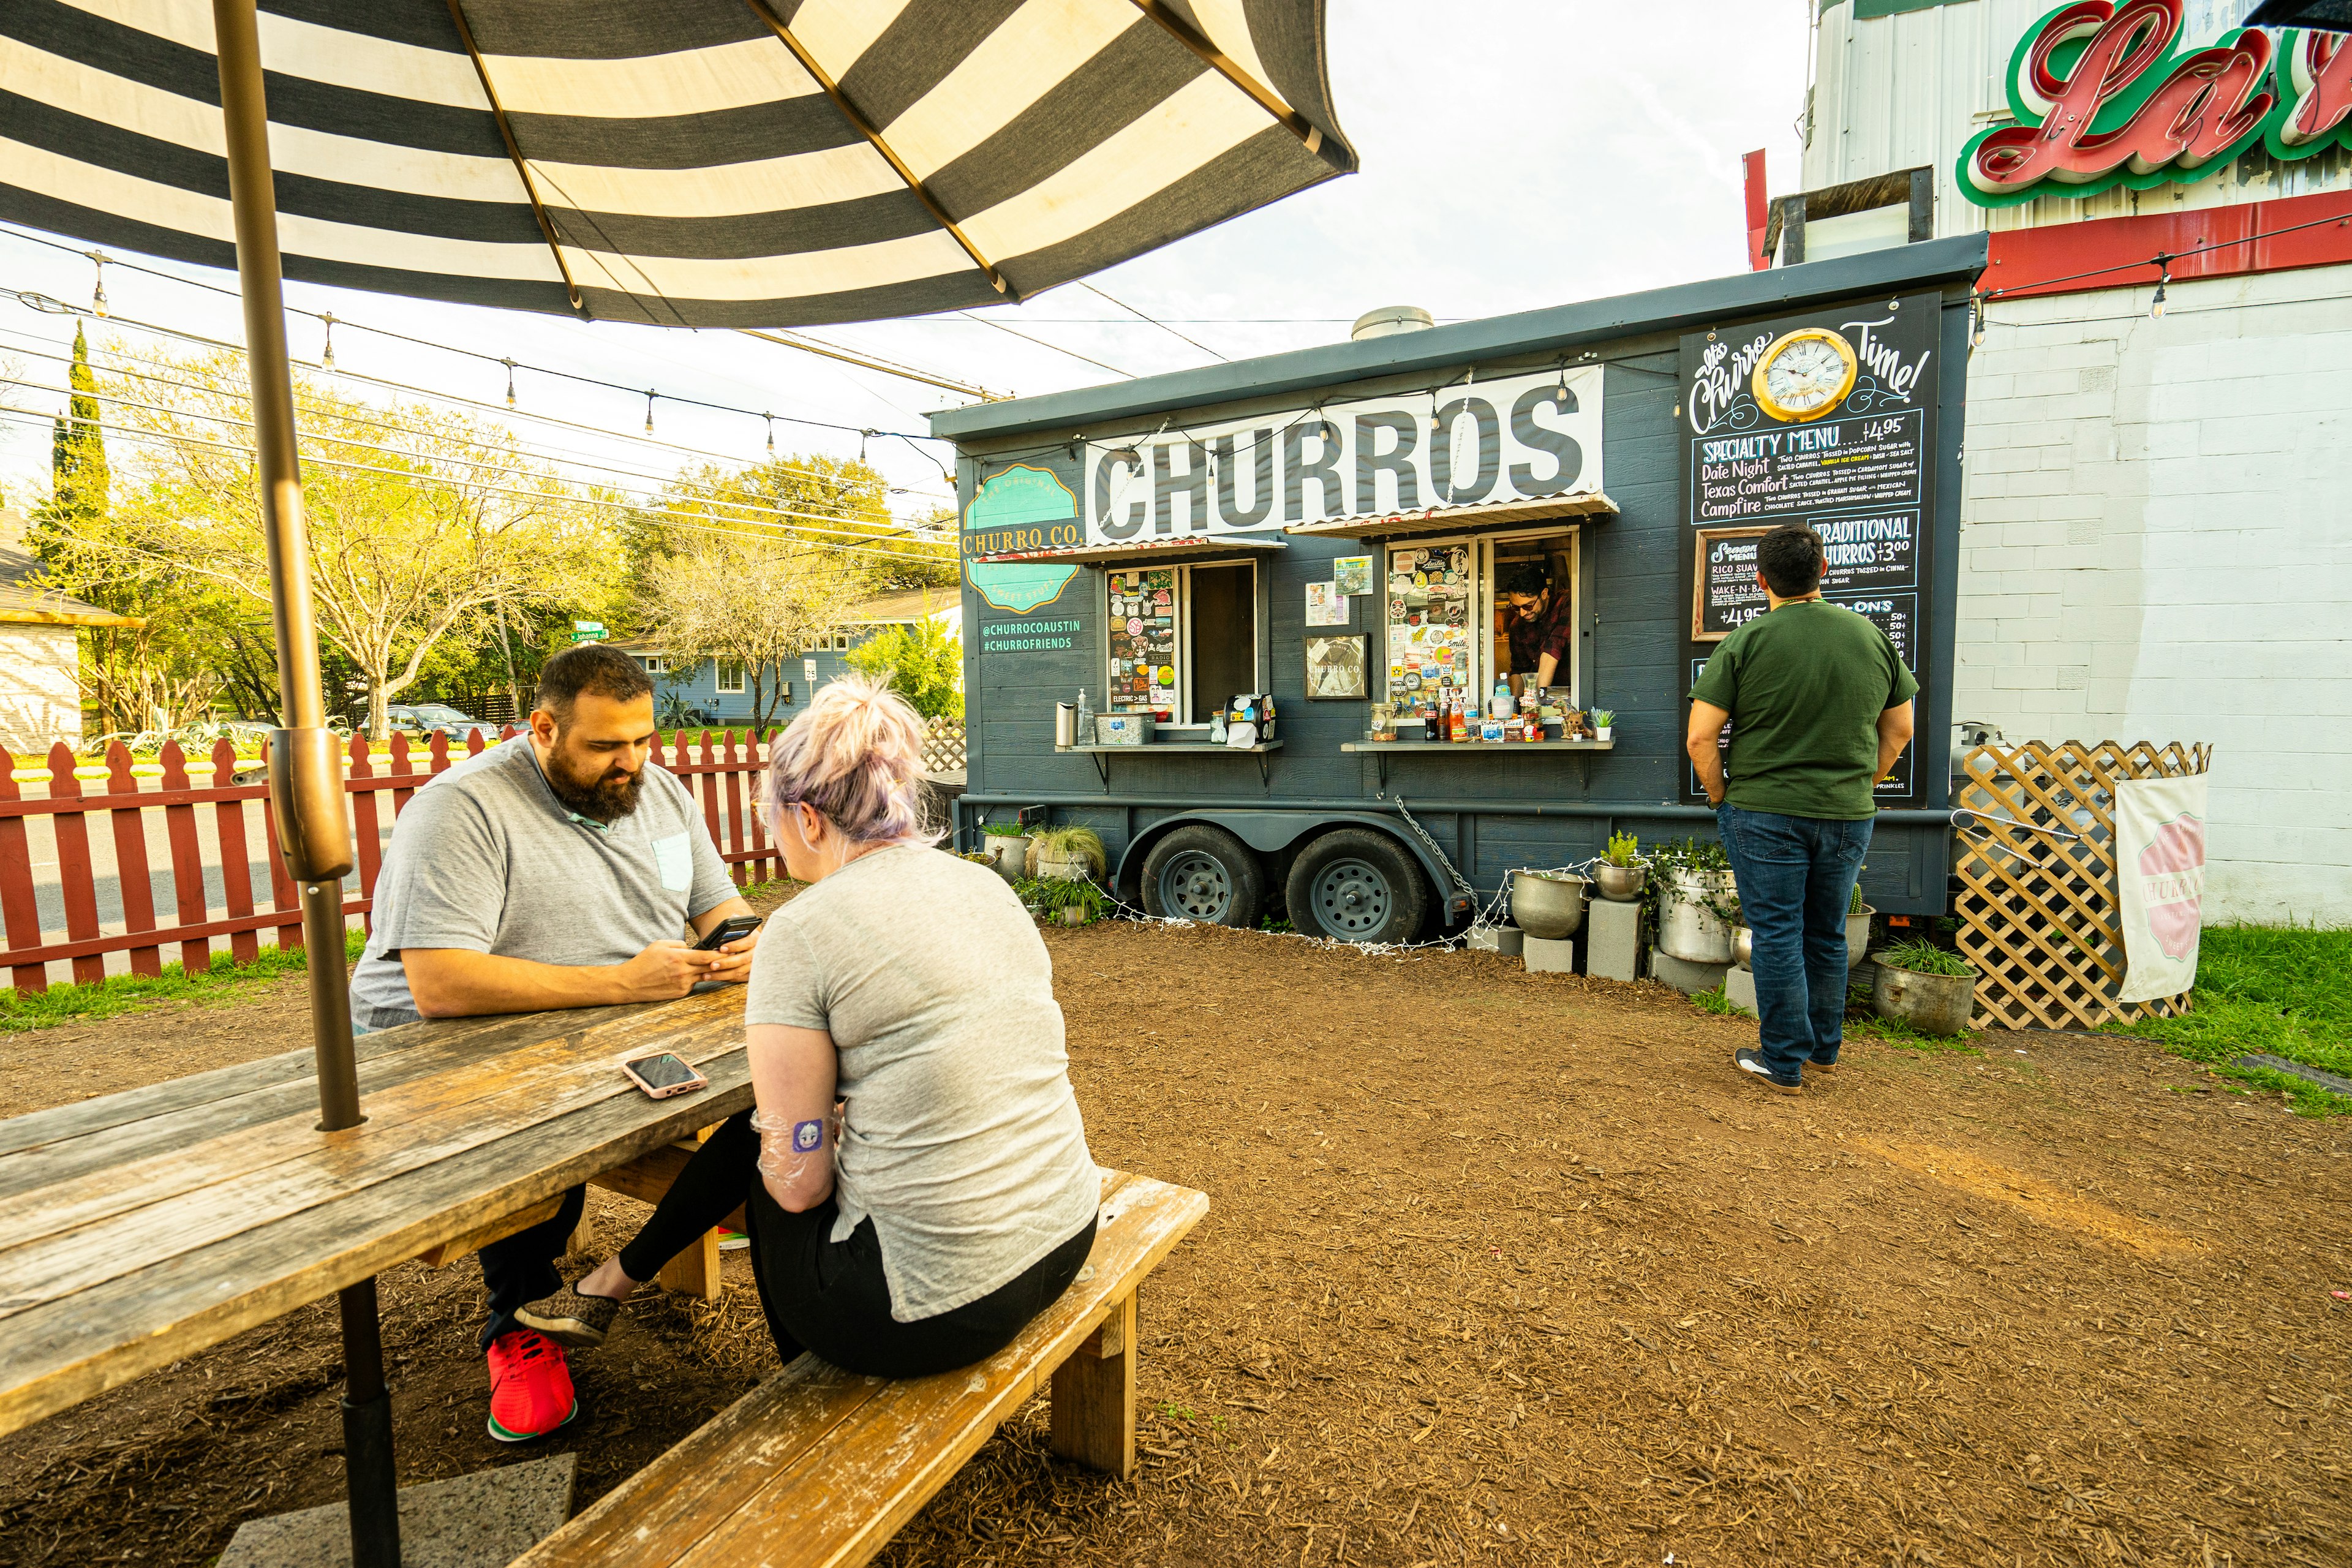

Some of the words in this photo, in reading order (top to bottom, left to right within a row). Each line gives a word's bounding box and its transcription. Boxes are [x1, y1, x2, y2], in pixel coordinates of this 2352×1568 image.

[1963, 0, 2274, 197] La
[1689, 331, 1773, 435] Churro
[1839, 315, 1930, 404] Time!
[1703, 434, 1782, 464] SPECIALTY
[1795, 452, 1821, 461] CHURROS
[1849, 445, 1877, 455] POPCORN
[1095, 385, 1582, 540] CHURROS
[1702, 463, 1730, 481] Date
[1732, 458, 1770, 479] Night
[1806, 471, 1831, 480] CHURROS
[1857, 464, 1888, 473] CARDAMOM
[1702, 483, 1736, 499] Texas
[1738, 474, 1789, 495] Comfort
[1777, 492, 1801, 501] CHURROS
[1877, 481, 1905, 490] MEXICAN
[1701, 497, 1761, 518] Campfire
[1764, 502, 1795, 511] CHOCOLATE
[1835, 493, 1872, 503] MARSHMALLOW
[963, 529, 1042, 554] CHURRO
[1050, 525, 1083, 545] CO.
[1812, 517, 1912, 545] TRADITIONAL
[1711, 542, 1757, 563] Season
[1823, 542, 1876, 567] HURROS
[1422, 559, 1446, 568] Austin
[1713, 565, 1733, 574] RICO
[1736, 564, 1758, 573] SUAV
[1855, 566, 1879, 575] TOSSED
[1711, 584, 1764, 595] WAKE-N-BA
[1831, 600, 1894, 613] D-ONS
[983, 620, 1080, 636] @CHURROCOAUSTIN
[984, 638, 1071, 652] #CHURROFRIENDS
